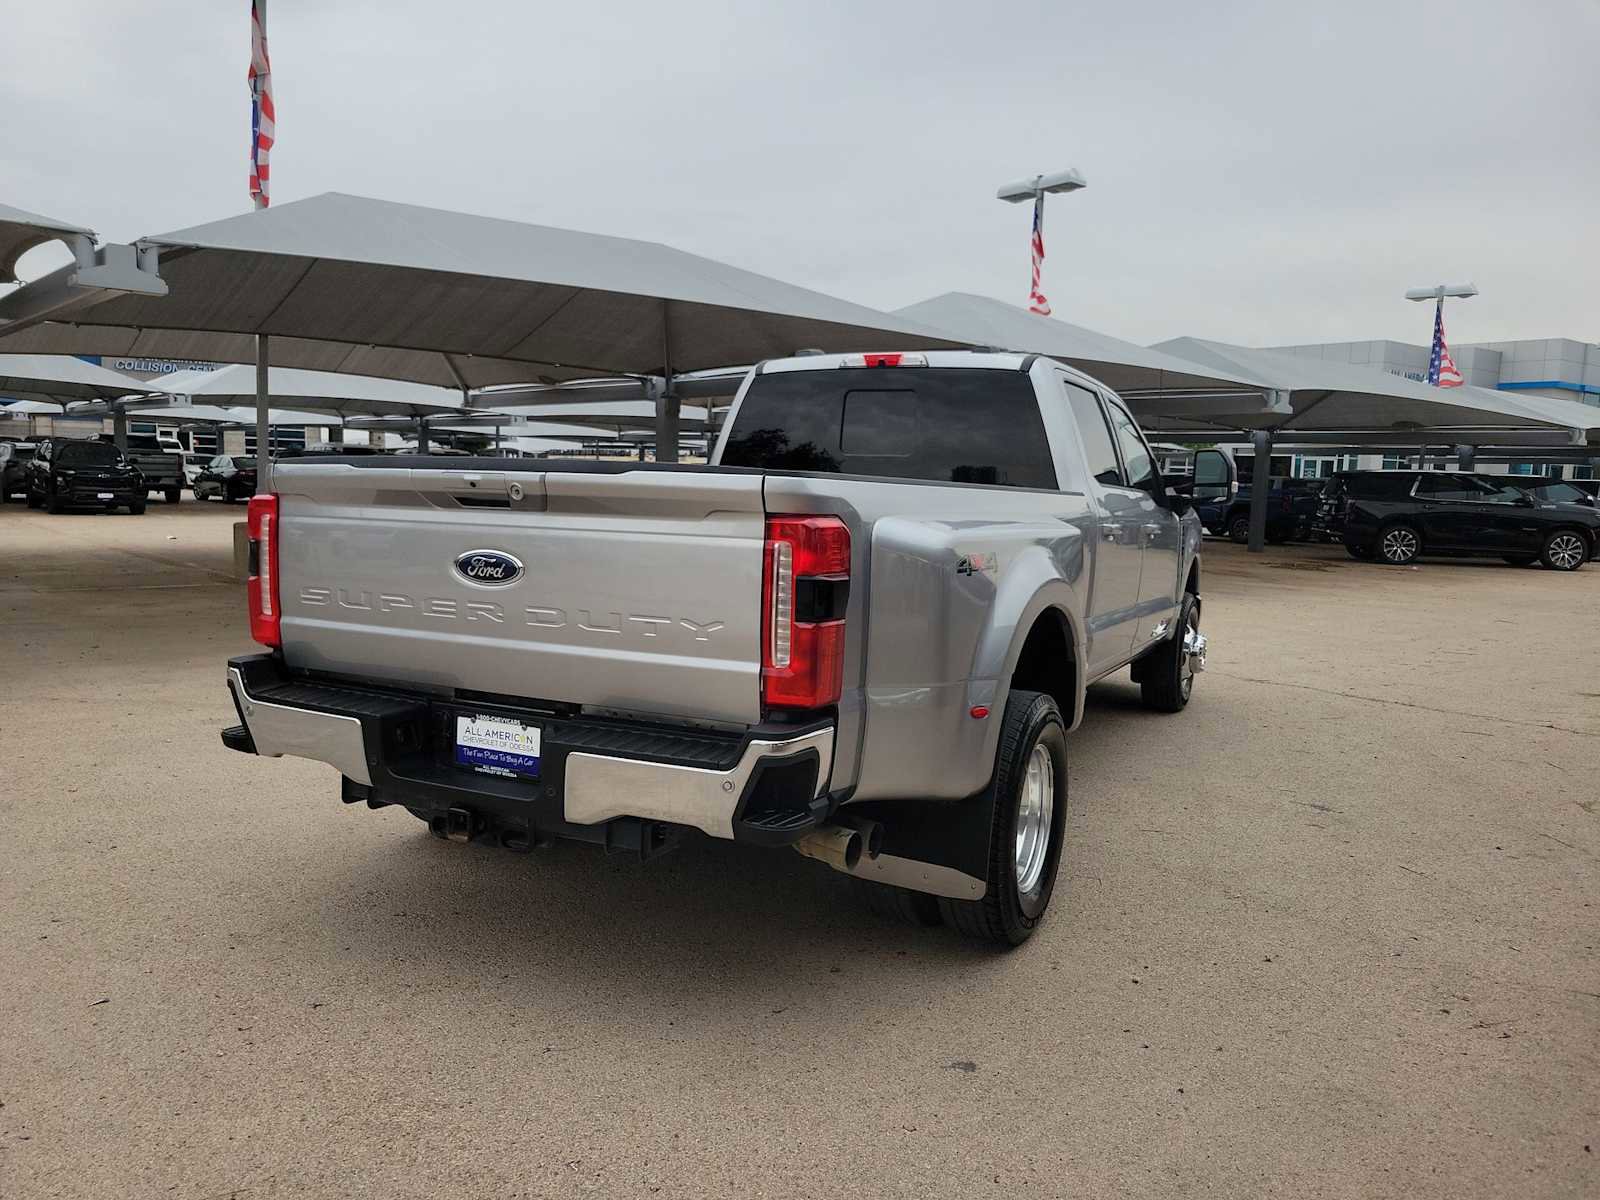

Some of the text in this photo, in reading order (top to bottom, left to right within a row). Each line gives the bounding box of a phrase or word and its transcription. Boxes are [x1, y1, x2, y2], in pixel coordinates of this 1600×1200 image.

[116, 360, 178, 373] COLLISION
[467, 554, 506, 581] Ford
[299, 586, 726, 641] SUPER DUTY
[465, 726, 482, 736] ALL
[463, 736, 498, 746] CHEVROLET
[509, 742, 535, 753] ODESSA
[463, 747, 474, 757] The
[499, 753, 507, 762] To
[517, 757, 524, 765] A
